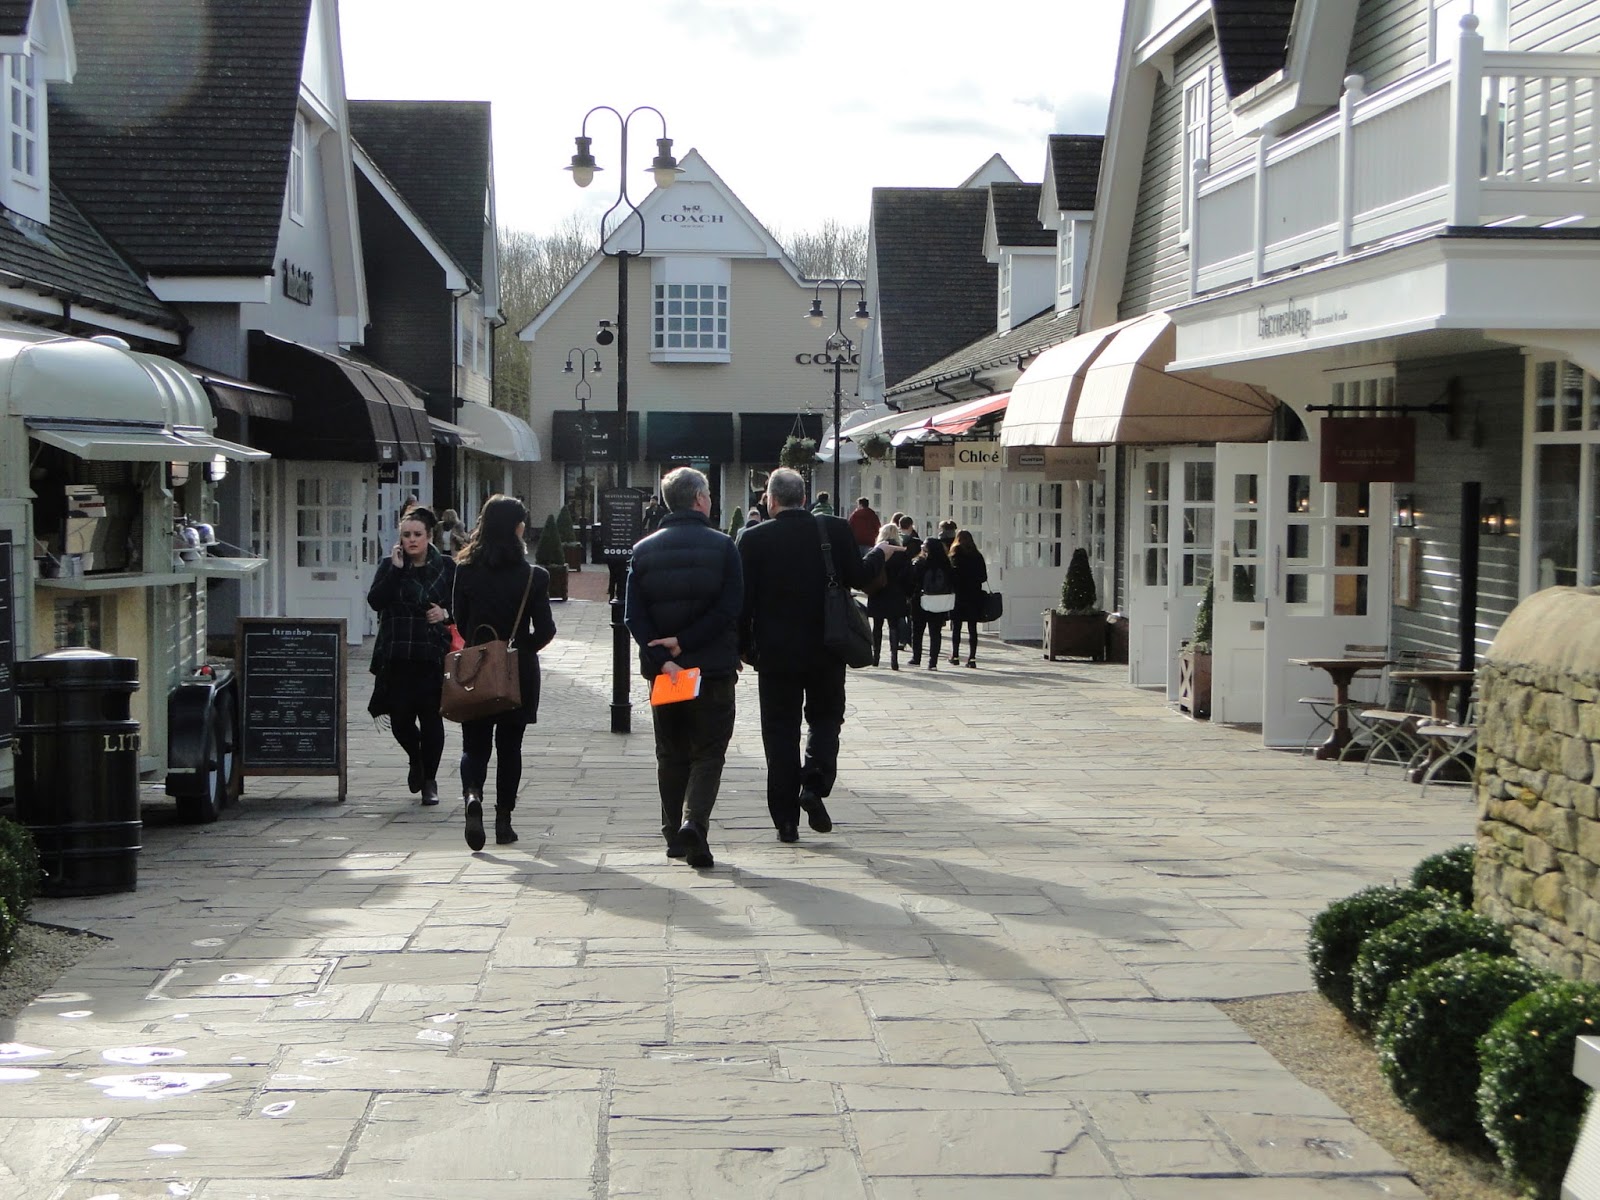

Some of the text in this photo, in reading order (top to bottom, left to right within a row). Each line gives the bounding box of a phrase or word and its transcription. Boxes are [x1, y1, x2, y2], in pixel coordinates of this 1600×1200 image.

[660, 214, 724, 223] COACH
[795, 353, 860, 365] COAC
[959, 449, 999, 463] Chloé
[103, 733, 141, 752] LIT
